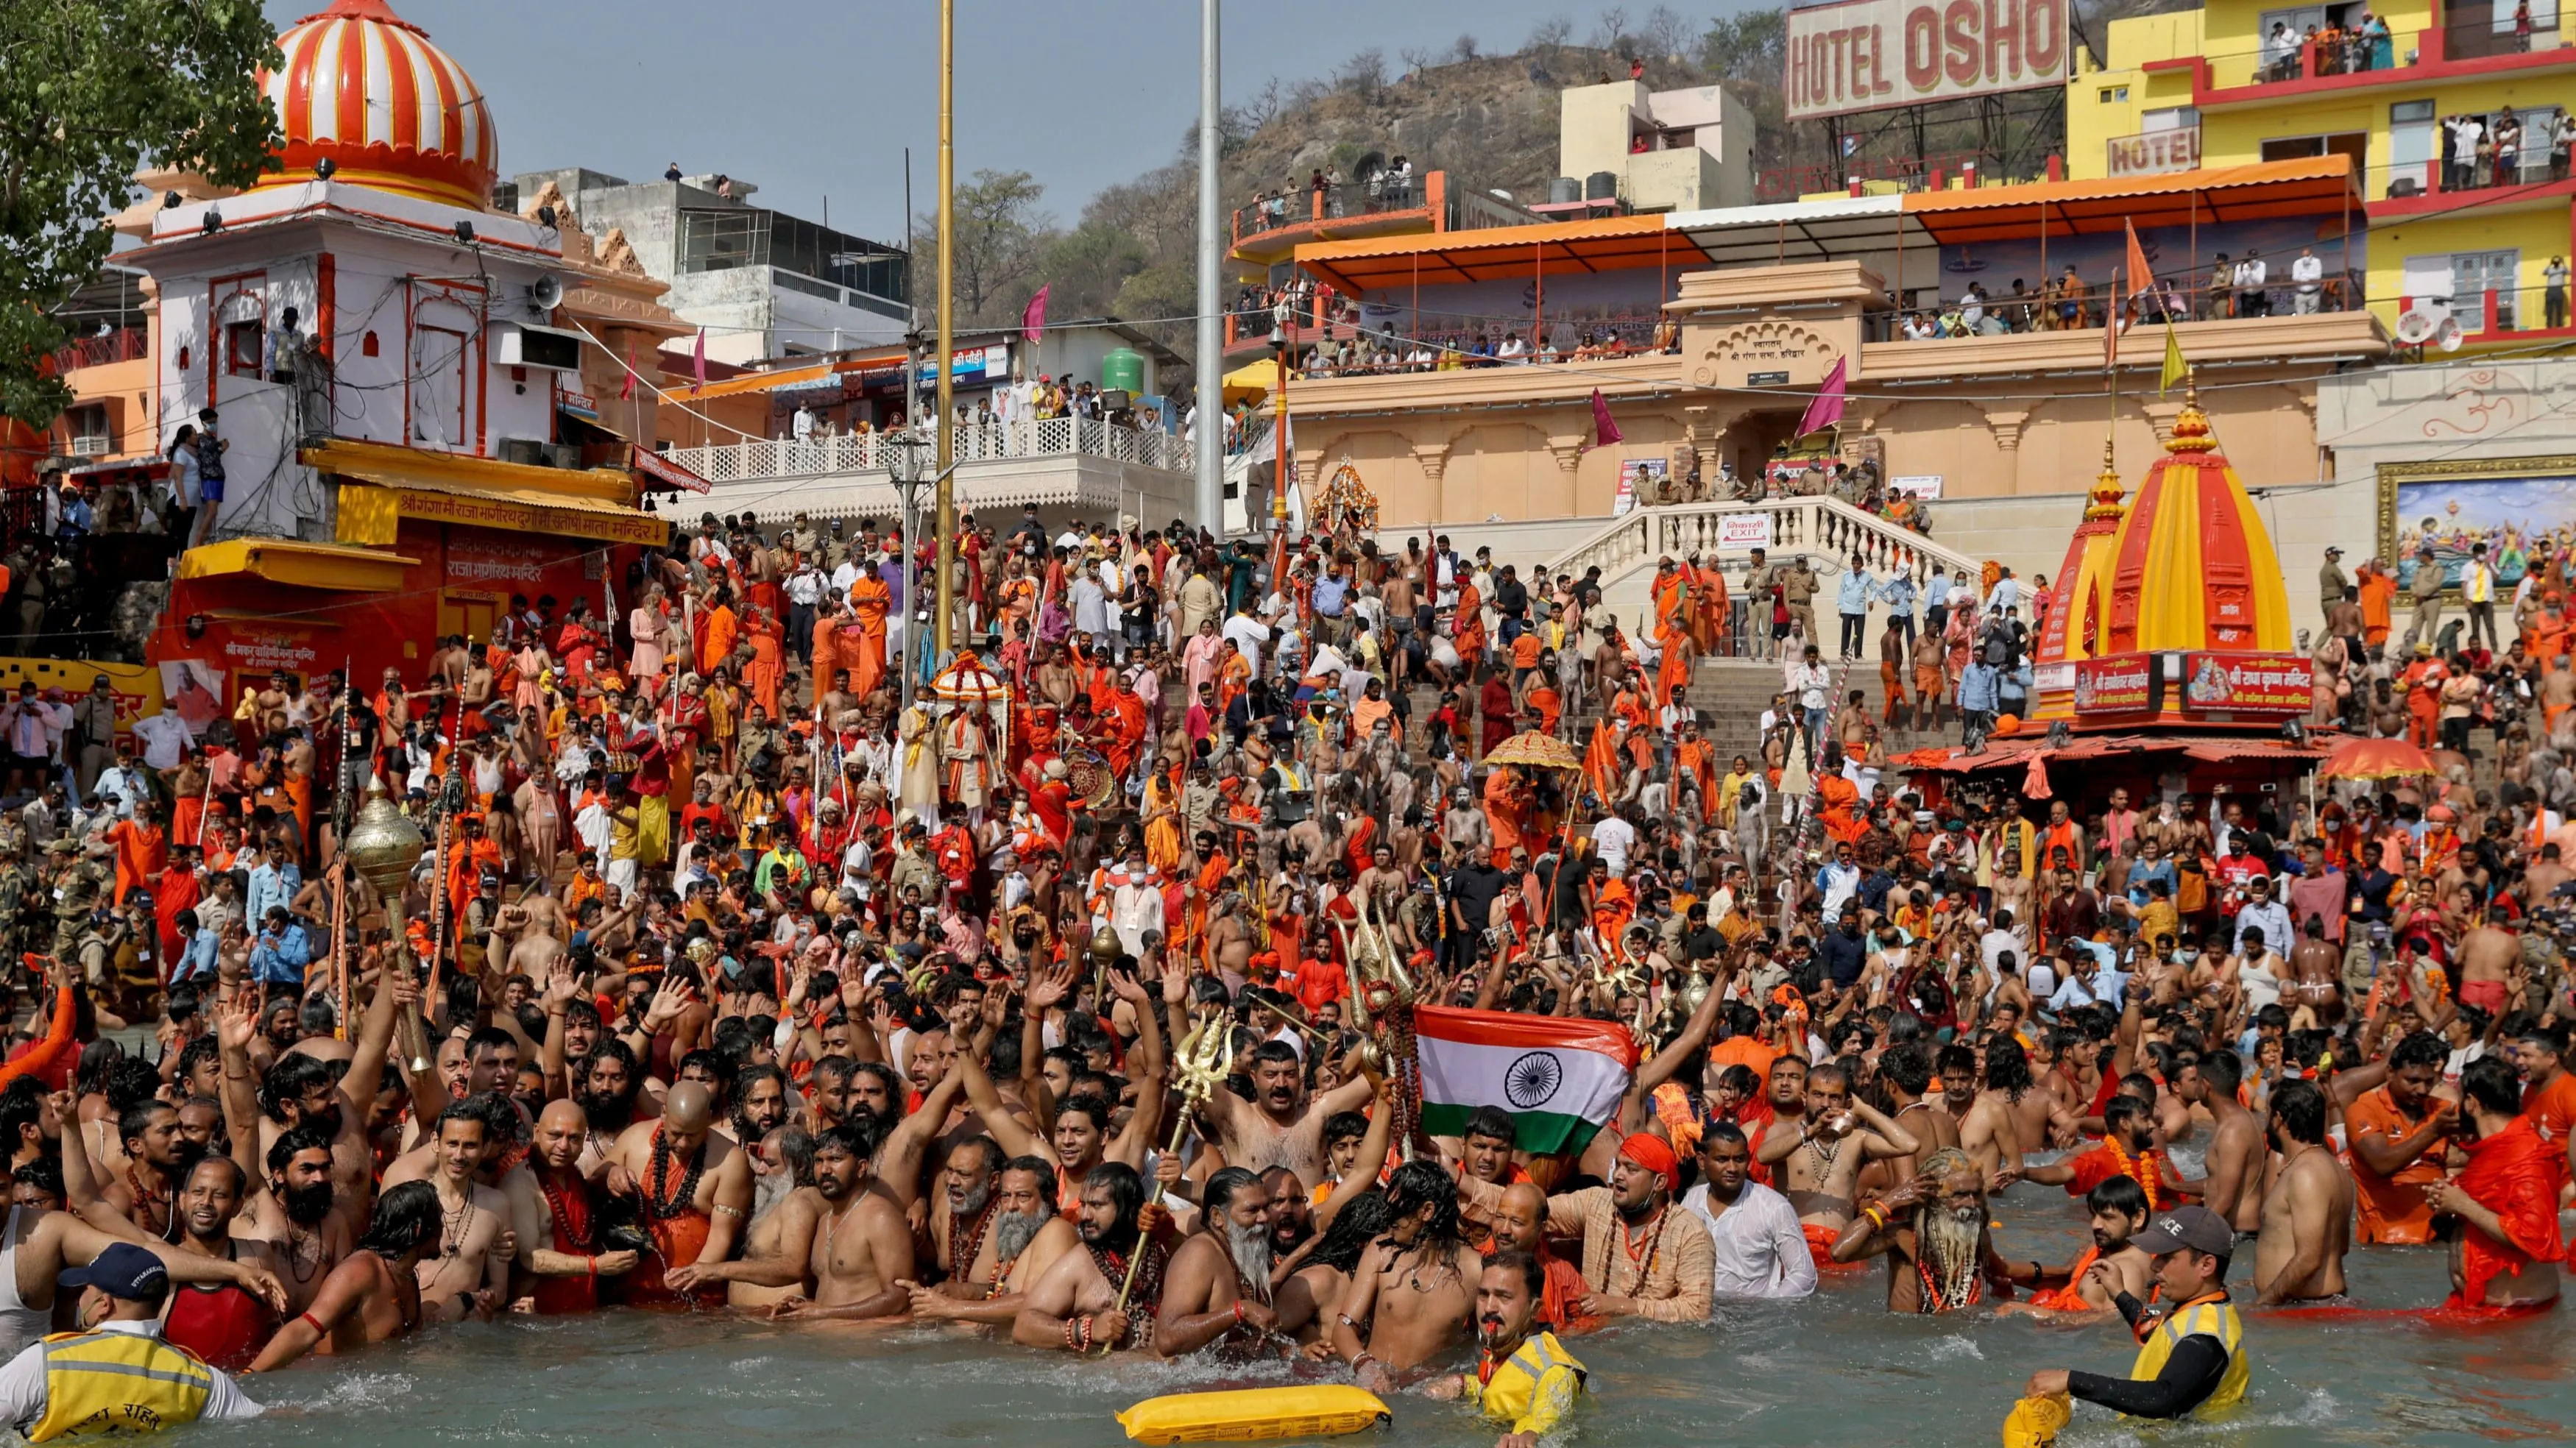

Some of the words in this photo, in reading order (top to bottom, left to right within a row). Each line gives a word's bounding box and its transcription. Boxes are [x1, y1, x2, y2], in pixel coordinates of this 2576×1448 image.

[1791, 24, 1893, 108] HOTEL
[1905, 0, 2064, 92] OSHO
[2112, 130, 2199, 172] HOTEL
[1731, 352, 1739, 361] श्री
[1743, 351, 1756, 360] गंगा
[1780, 349, 1805, 358] हरिद्वार
[1753, 340, 1782, 349] स्वागतम्
[401, 494, 415, 512] श्री
[417, 496, 441, 514] गंगा
[456, 503, 478, 519] राजा
[479, 503, 516, 523] भागीरथ
[584, 517, 609, 535] माता
[612, 519, 651, 539] मन्दिर
[1727, 520, 1763, 529] निकासी
[447, 561, 472, 577] राजा
[2229, 665, 2241, 685] श्री
[2242, 671, 2260, 686] राधा
[2262, 672, 2282, 692] कृष्ण
[2284, 667, 2310, 687] मन्दिर
